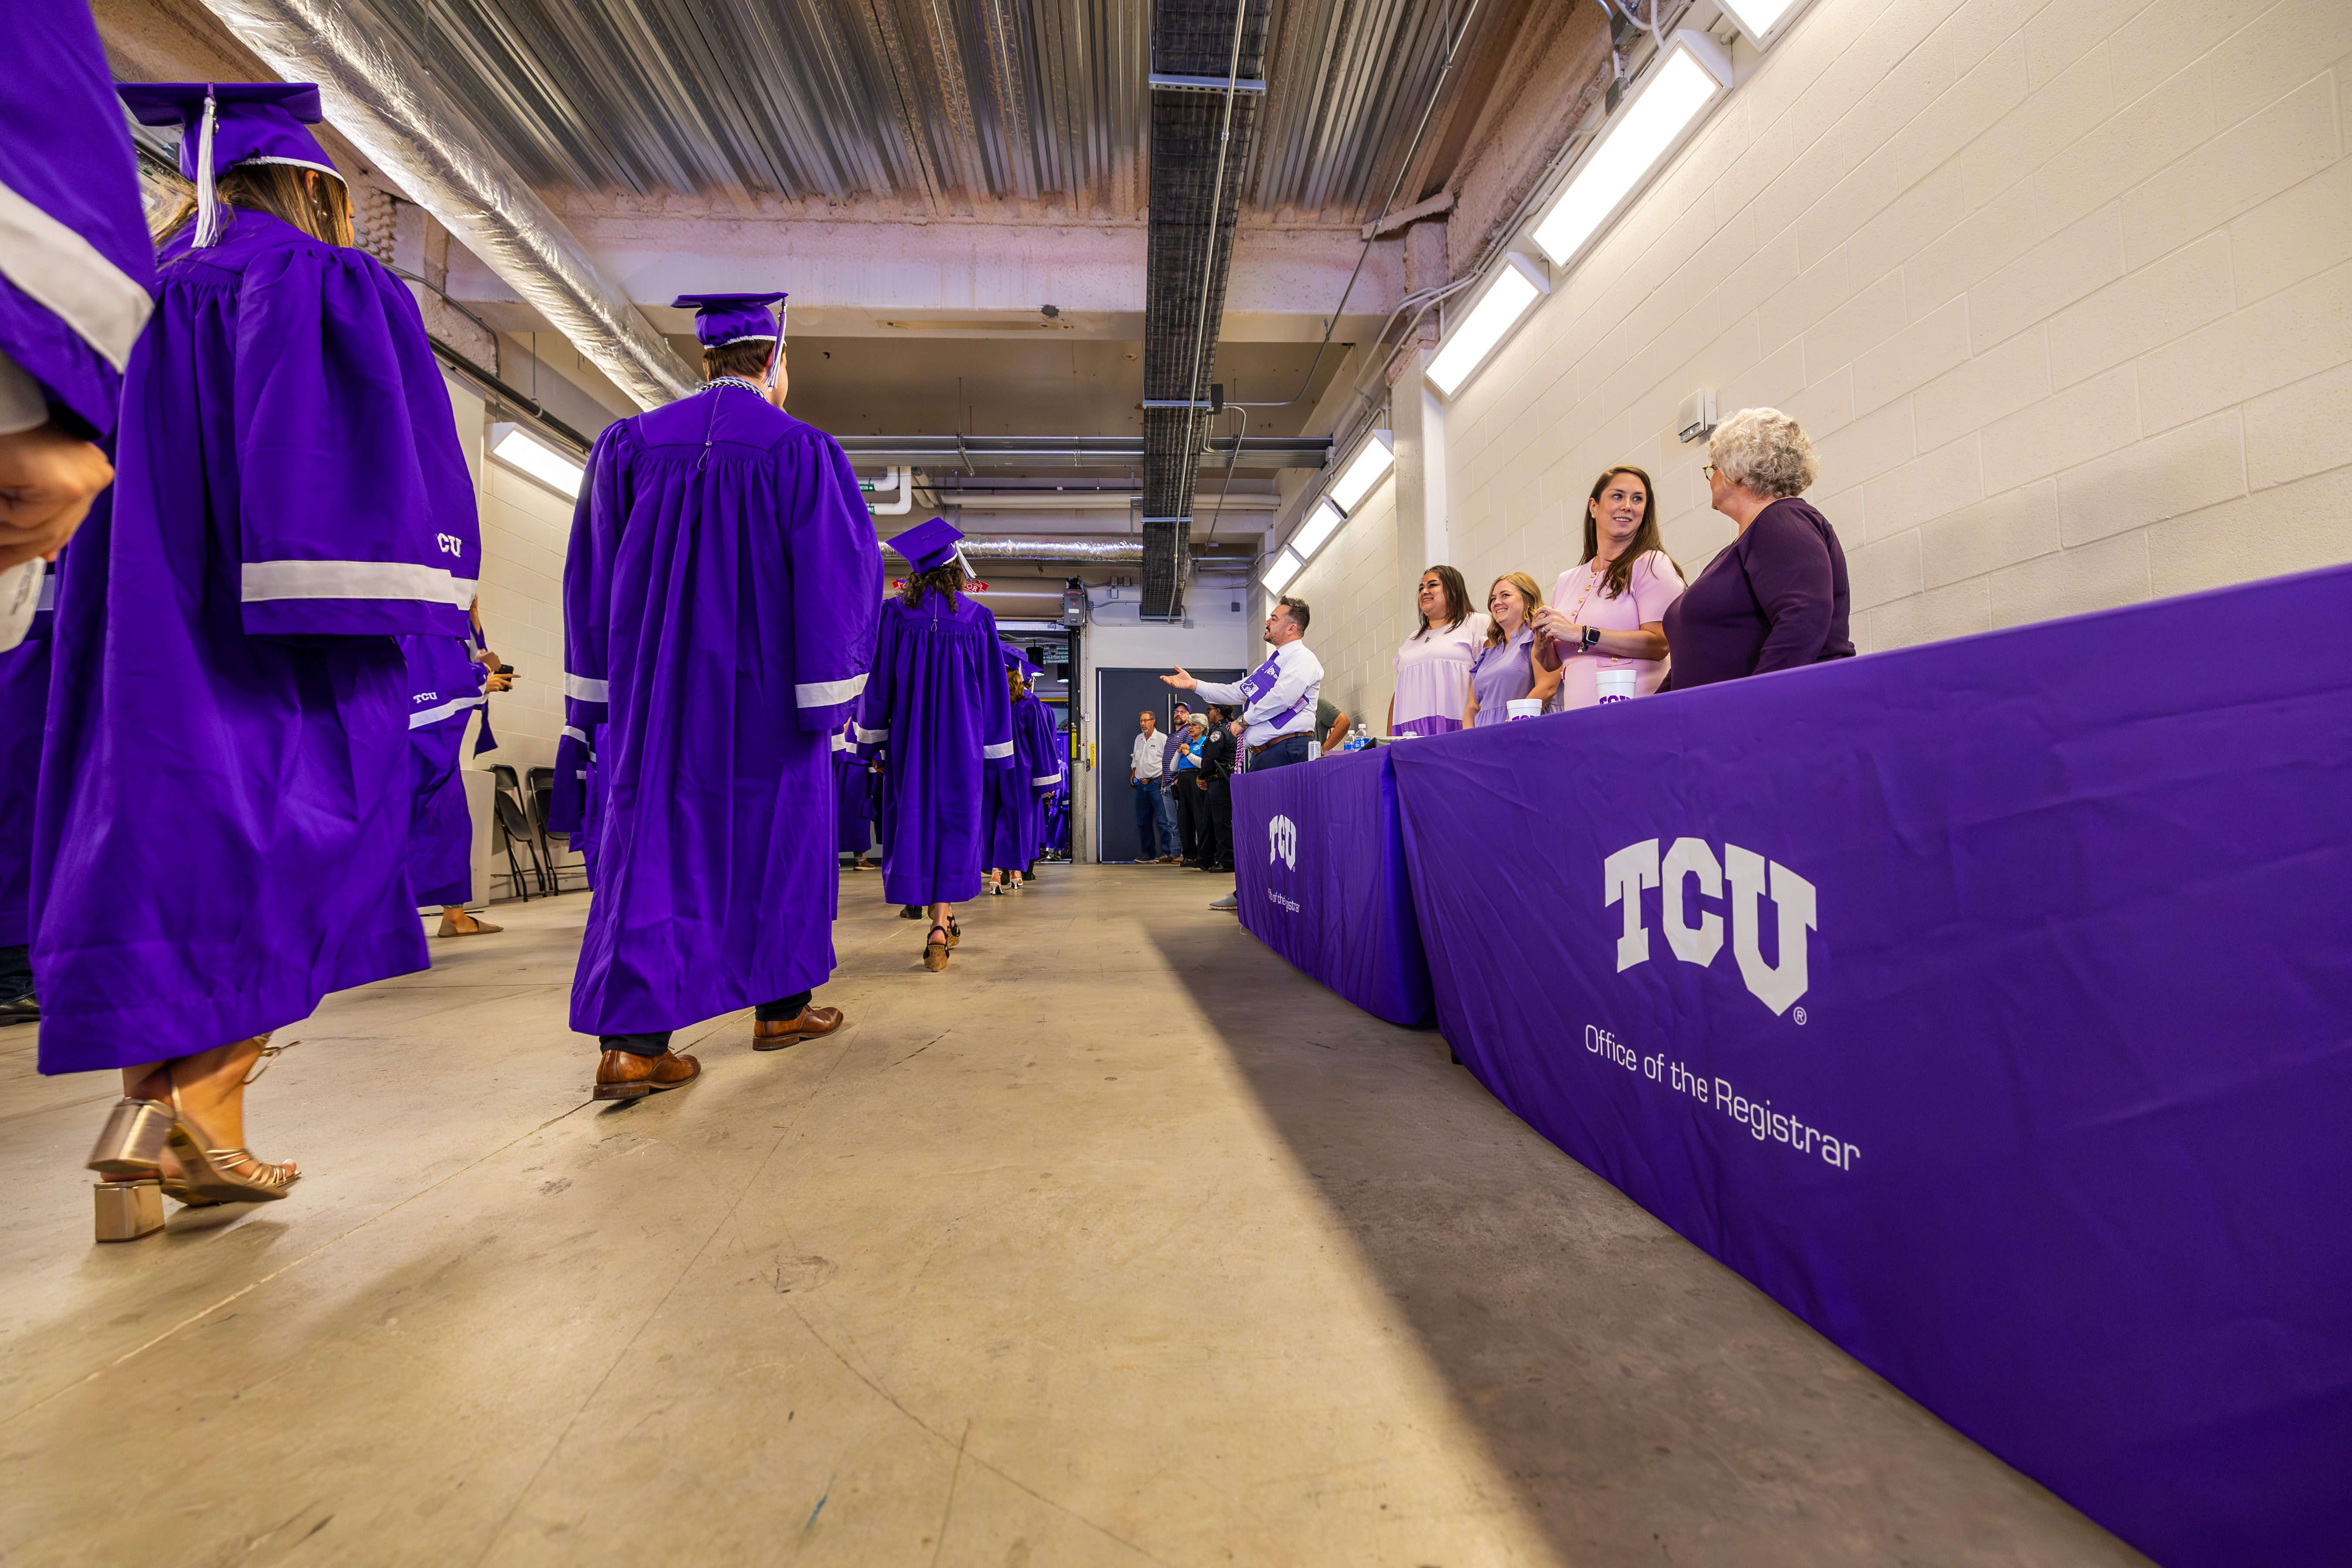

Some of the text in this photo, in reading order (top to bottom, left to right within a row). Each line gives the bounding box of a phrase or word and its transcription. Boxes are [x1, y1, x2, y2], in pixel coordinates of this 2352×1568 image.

[435, 533, 462, 558] CU
[413, 692, 437, 704] TCU
[1269, 814, 1296, 871] TCU
[1604, 837, 1817, 1017] TCU
[1586, 1024, 1860, 1171] Office of the Registrar
